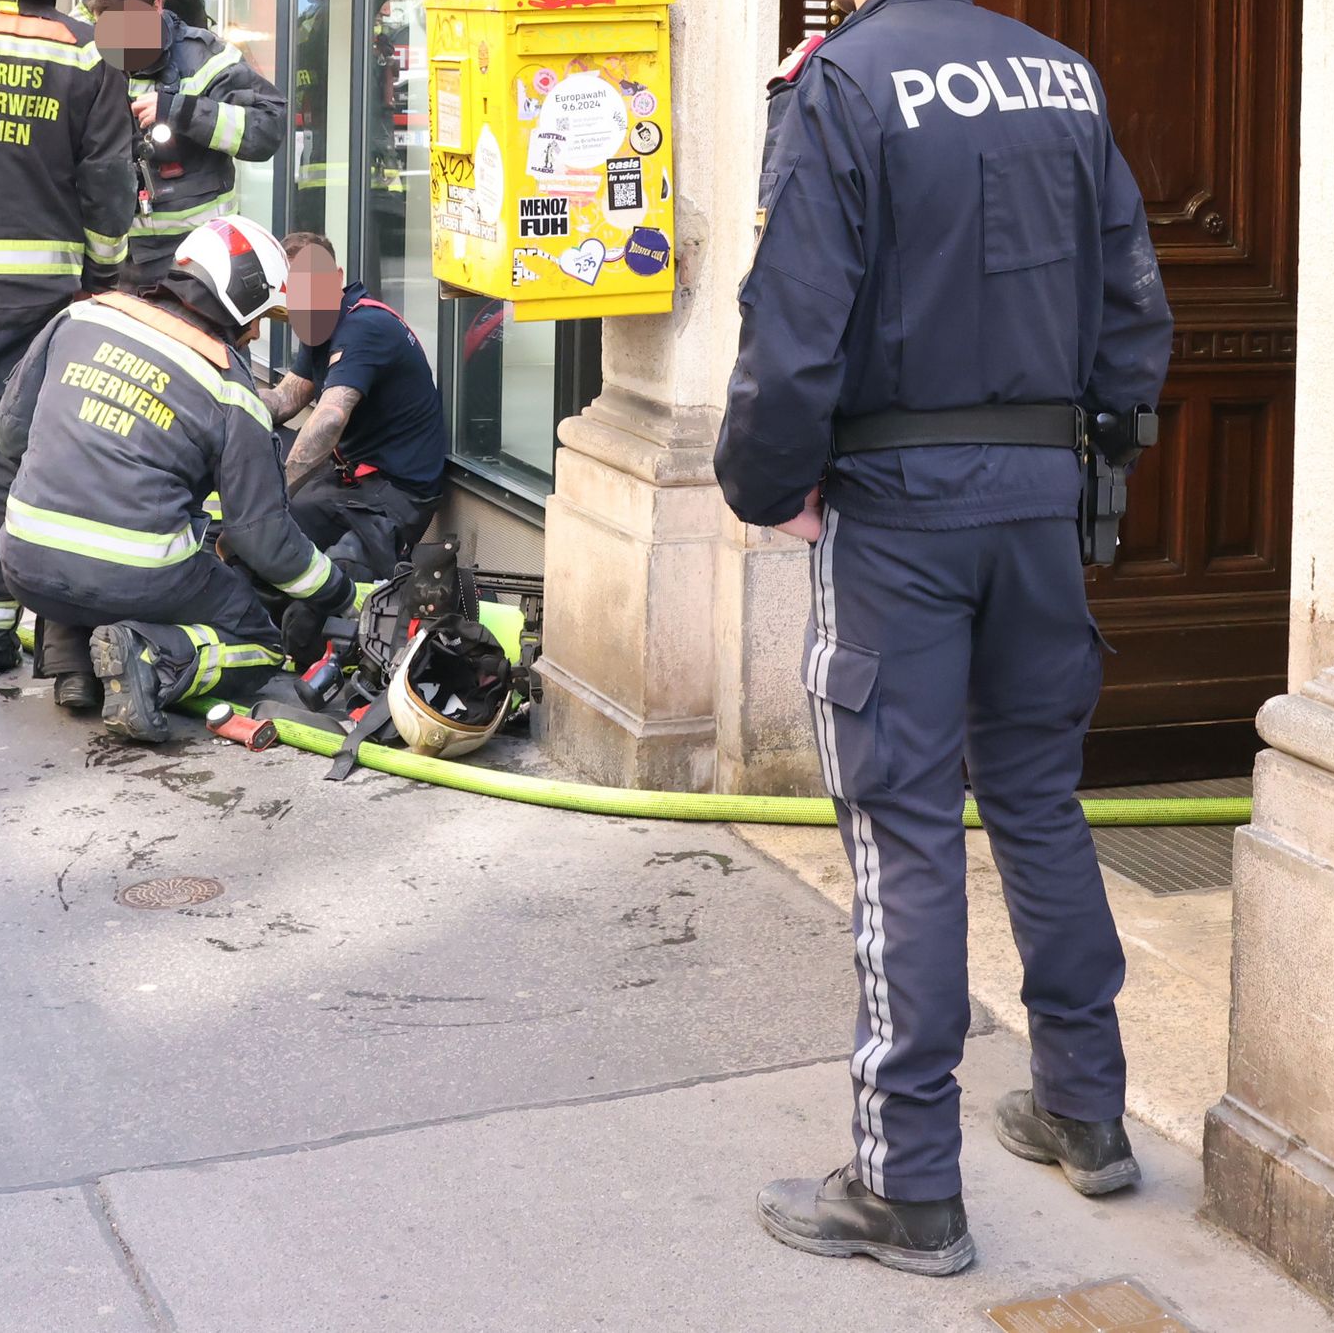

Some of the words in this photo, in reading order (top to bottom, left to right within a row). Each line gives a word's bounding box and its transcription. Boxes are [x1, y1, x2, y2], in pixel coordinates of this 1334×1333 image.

[555, 89, 607, 103] Europawahl
[890, 55, 1099, 129] POLIZEI
[561, 100, 601, 112] 9.6.2024
[537, 132, 566, 142] AUSTRIA
[608, 158, 640, 170] oasis
[608, 173, 618, 181] in
[619, 171, 640, 181] wien
[520, 198, 568, 217] MENOZ
[520, 217, 568, 236] FUH
[92, 341, 171, 394] BERUFS
[60, 361, 175, 431] FEUERWEHR
[78, 396, 137, 437] WIEN
